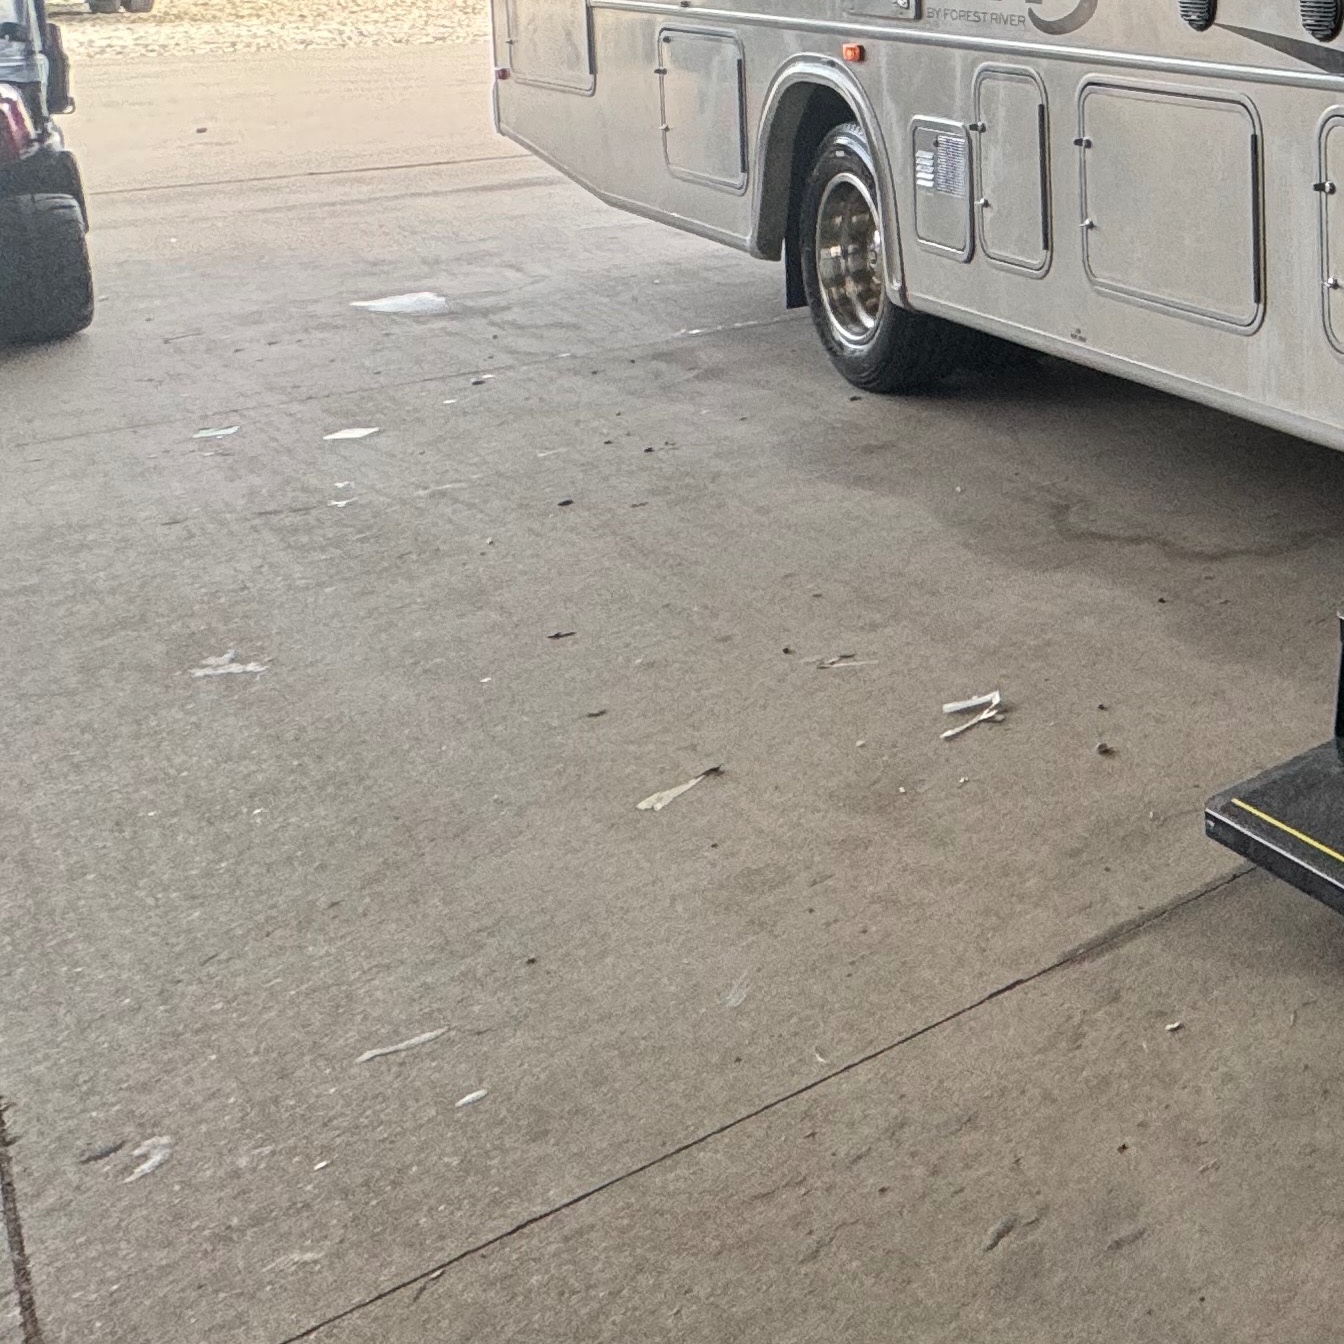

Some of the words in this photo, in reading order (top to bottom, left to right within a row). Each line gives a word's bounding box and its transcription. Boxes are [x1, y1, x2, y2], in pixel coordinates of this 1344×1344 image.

[927, 7, 941, 19] BY
[944, 9, 988, 23] FOREST
[990, 11, 1026, 27] RIVER
